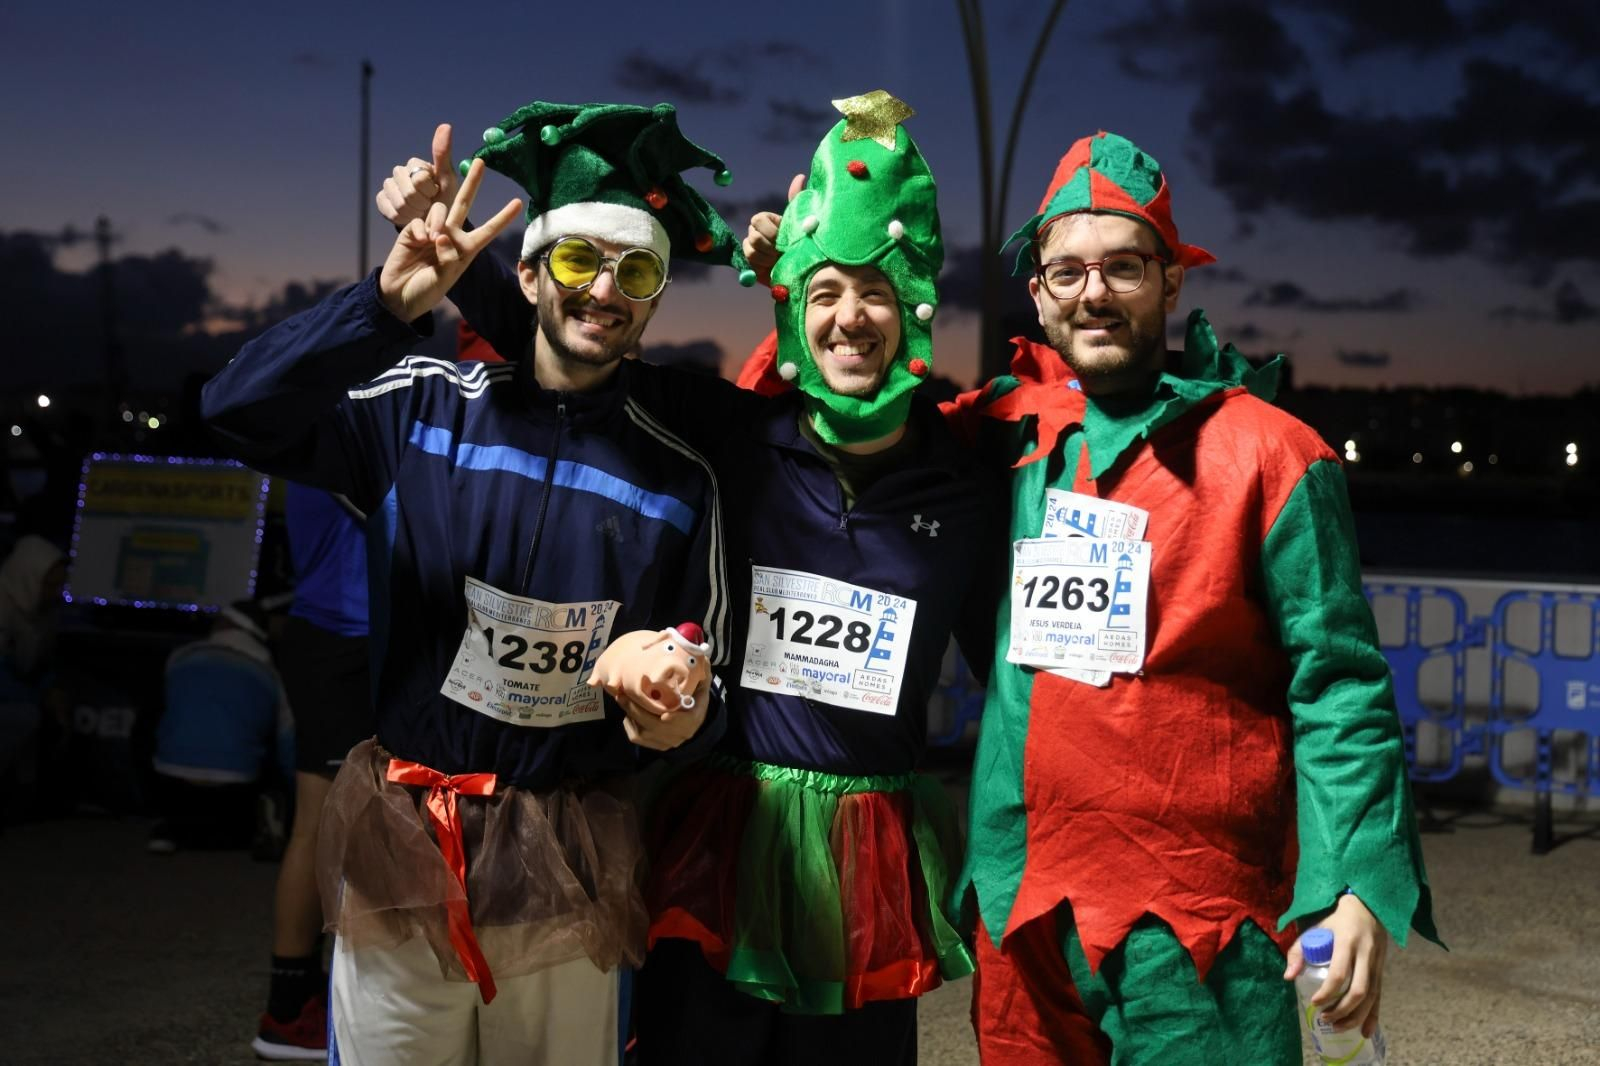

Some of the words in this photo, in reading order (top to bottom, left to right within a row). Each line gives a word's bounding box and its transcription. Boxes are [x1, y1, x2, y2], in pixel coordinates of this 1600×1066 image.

[754, 573, 770, 585] SAN
[773, 576, 820, 593] SILVESTRE
[1023, 575, 1110, 612] 1263
[484, 593, 533, 619] SILVESTRE
[770, 607, 872, 653] 1228
[1029, 620, 1049, 628] JESUS
[1052, 620, 1082, 630] VERDEJA
[1045, 633, 1095, 646] mayoral
[483, 626, 585, 674] 1238
[784, 652, 839, 668] MAMMADAGHA
[802, 668, 851, 684] mayoral
[860, 674, 888, 684] AEDAS
[503, 678, 541, 692] TOMATE
[858, 680, 887, 690] HOMES
[508, 690, 566, 707] mayoral
